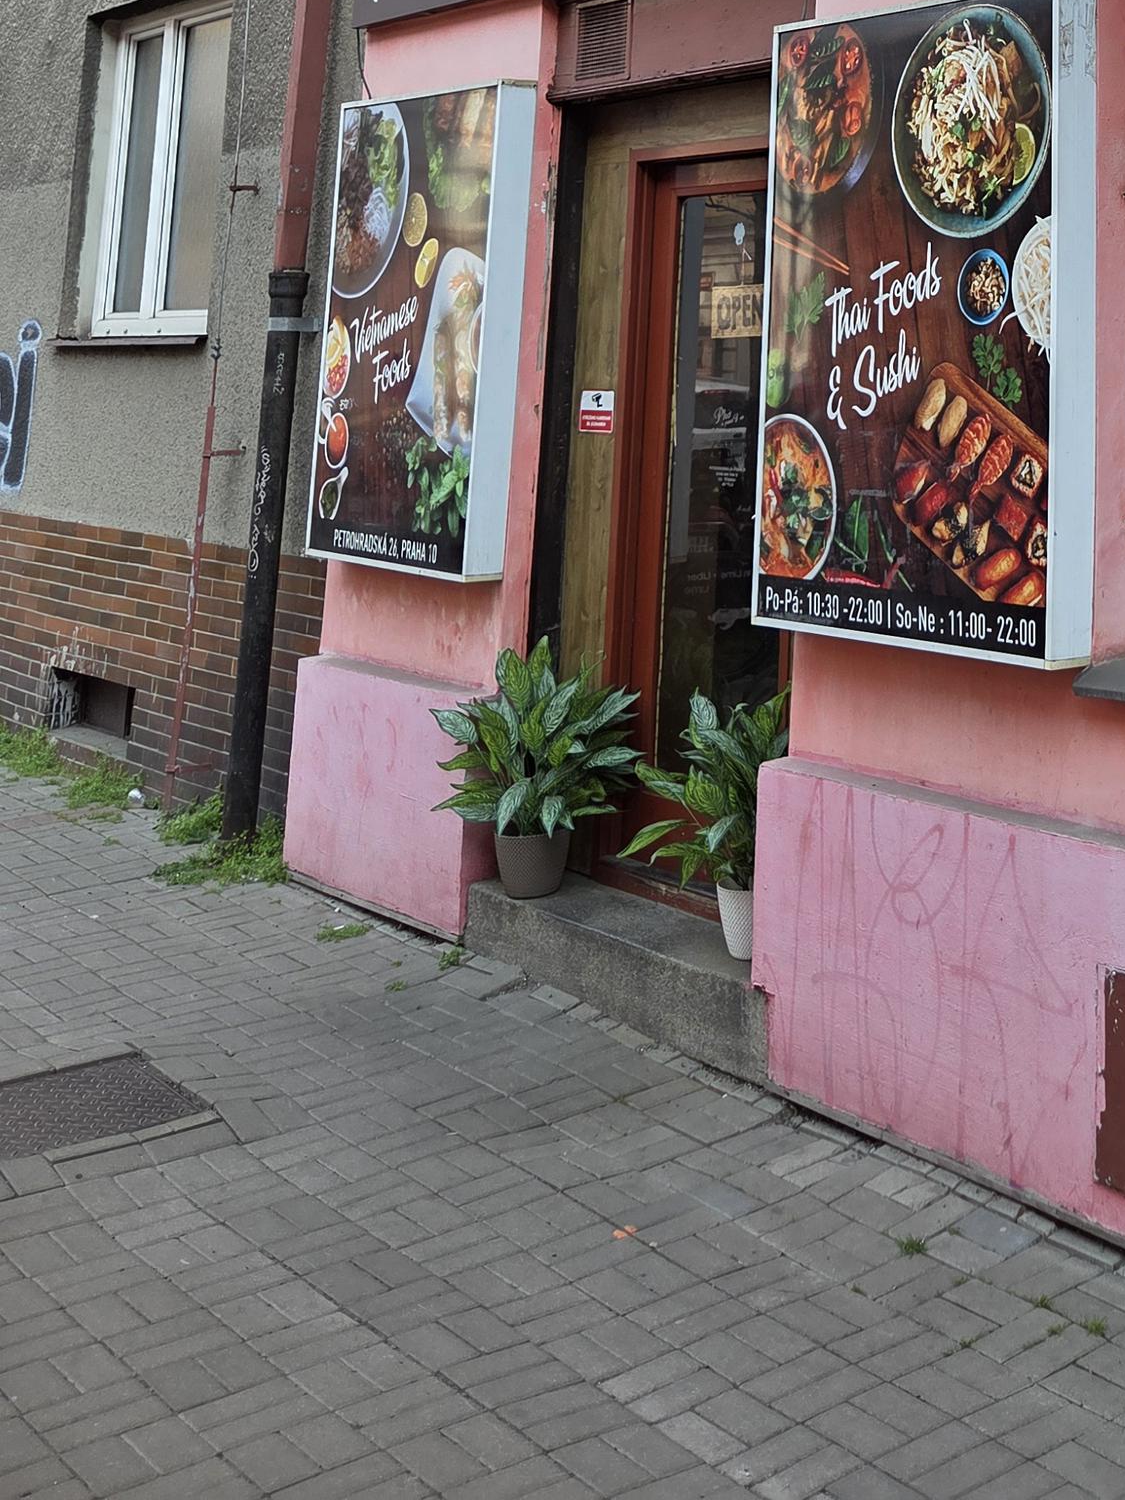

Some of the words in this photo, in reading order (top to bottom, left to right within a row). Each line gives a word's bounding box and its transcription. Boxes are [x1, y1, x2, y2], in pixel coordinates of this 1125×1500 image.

[350, 295, 419, 363] Vietnamese
[825, 287, 871, 358] Thai
[870, 241, 942, 333] Foods
[372, 338, 411, 404] Foods
[826, 365, 847, 430] &
[852, 328, 920, 417] Sushi
[333, 529, 387, 555] PETROHRADSKÁ
[401, 539, 426, 562] PRAHA
[428, 543, 438, 564] 10
[765, 586, 803, 614] Po-Pá:
[807, 590, 839, 619] 10:30
[896, 603, 936, 632] So-Ne
[997, 616, 1036, 647] 22:00
